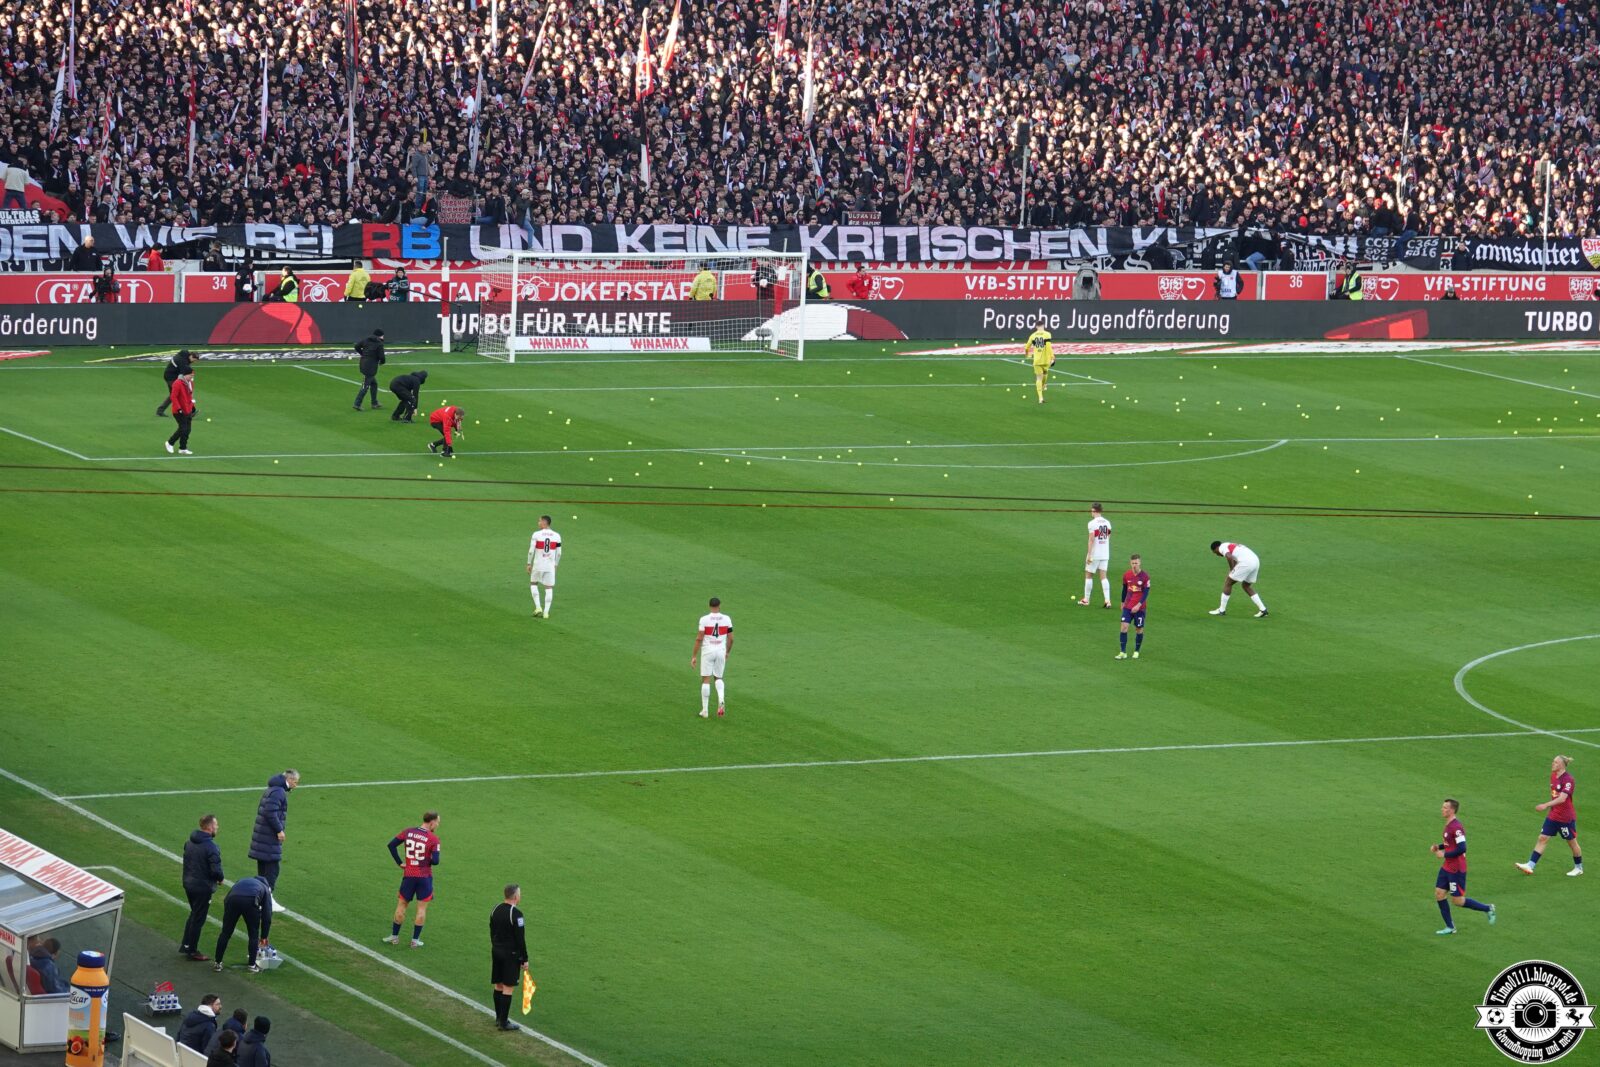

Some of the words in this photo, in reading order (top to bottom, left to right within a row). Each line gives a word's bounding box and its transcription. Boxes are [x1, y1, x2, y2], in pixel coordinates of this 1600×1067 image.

[0, 210, 40, 219] ULTRAS
[362, 224, 441, 259] RB
[470, 225, 593, 260] UND
[615, 224, 771, 253] KEINE
[799, 225, 1108, 261] KRITISCHEN
[1471, 241, 1580, 266] annstatter
[212, 277, 227, 290] 34
[549, 281, 692, 301] JOKERSTAR
[965, 275, 1077, 291] VfB-STIFTU
[1290, 276, 1302, 288] 36
[1424, 276, 1547, 292] VfB-STIFTUNG
[0, 313, 98, 341] örderung
[523, 308, 566, 334] FÜR
[573, 312, 672, 334] TALENTE
[983, 308, 1060, 330] Porsche
[1067, 308, 1230, 334] Jugendförderung
[1525, 311, 1593, 332] TURBO
[530, 338, 589, 349] WINAMAX
[631, 338, 689, 350] WINAMAX
[543, 537, 551, 553] 8
[712, 623, 719, 638] 4
[405, 839, 426, 861] 22
[31, 859, 117, 904] WINAMAX
